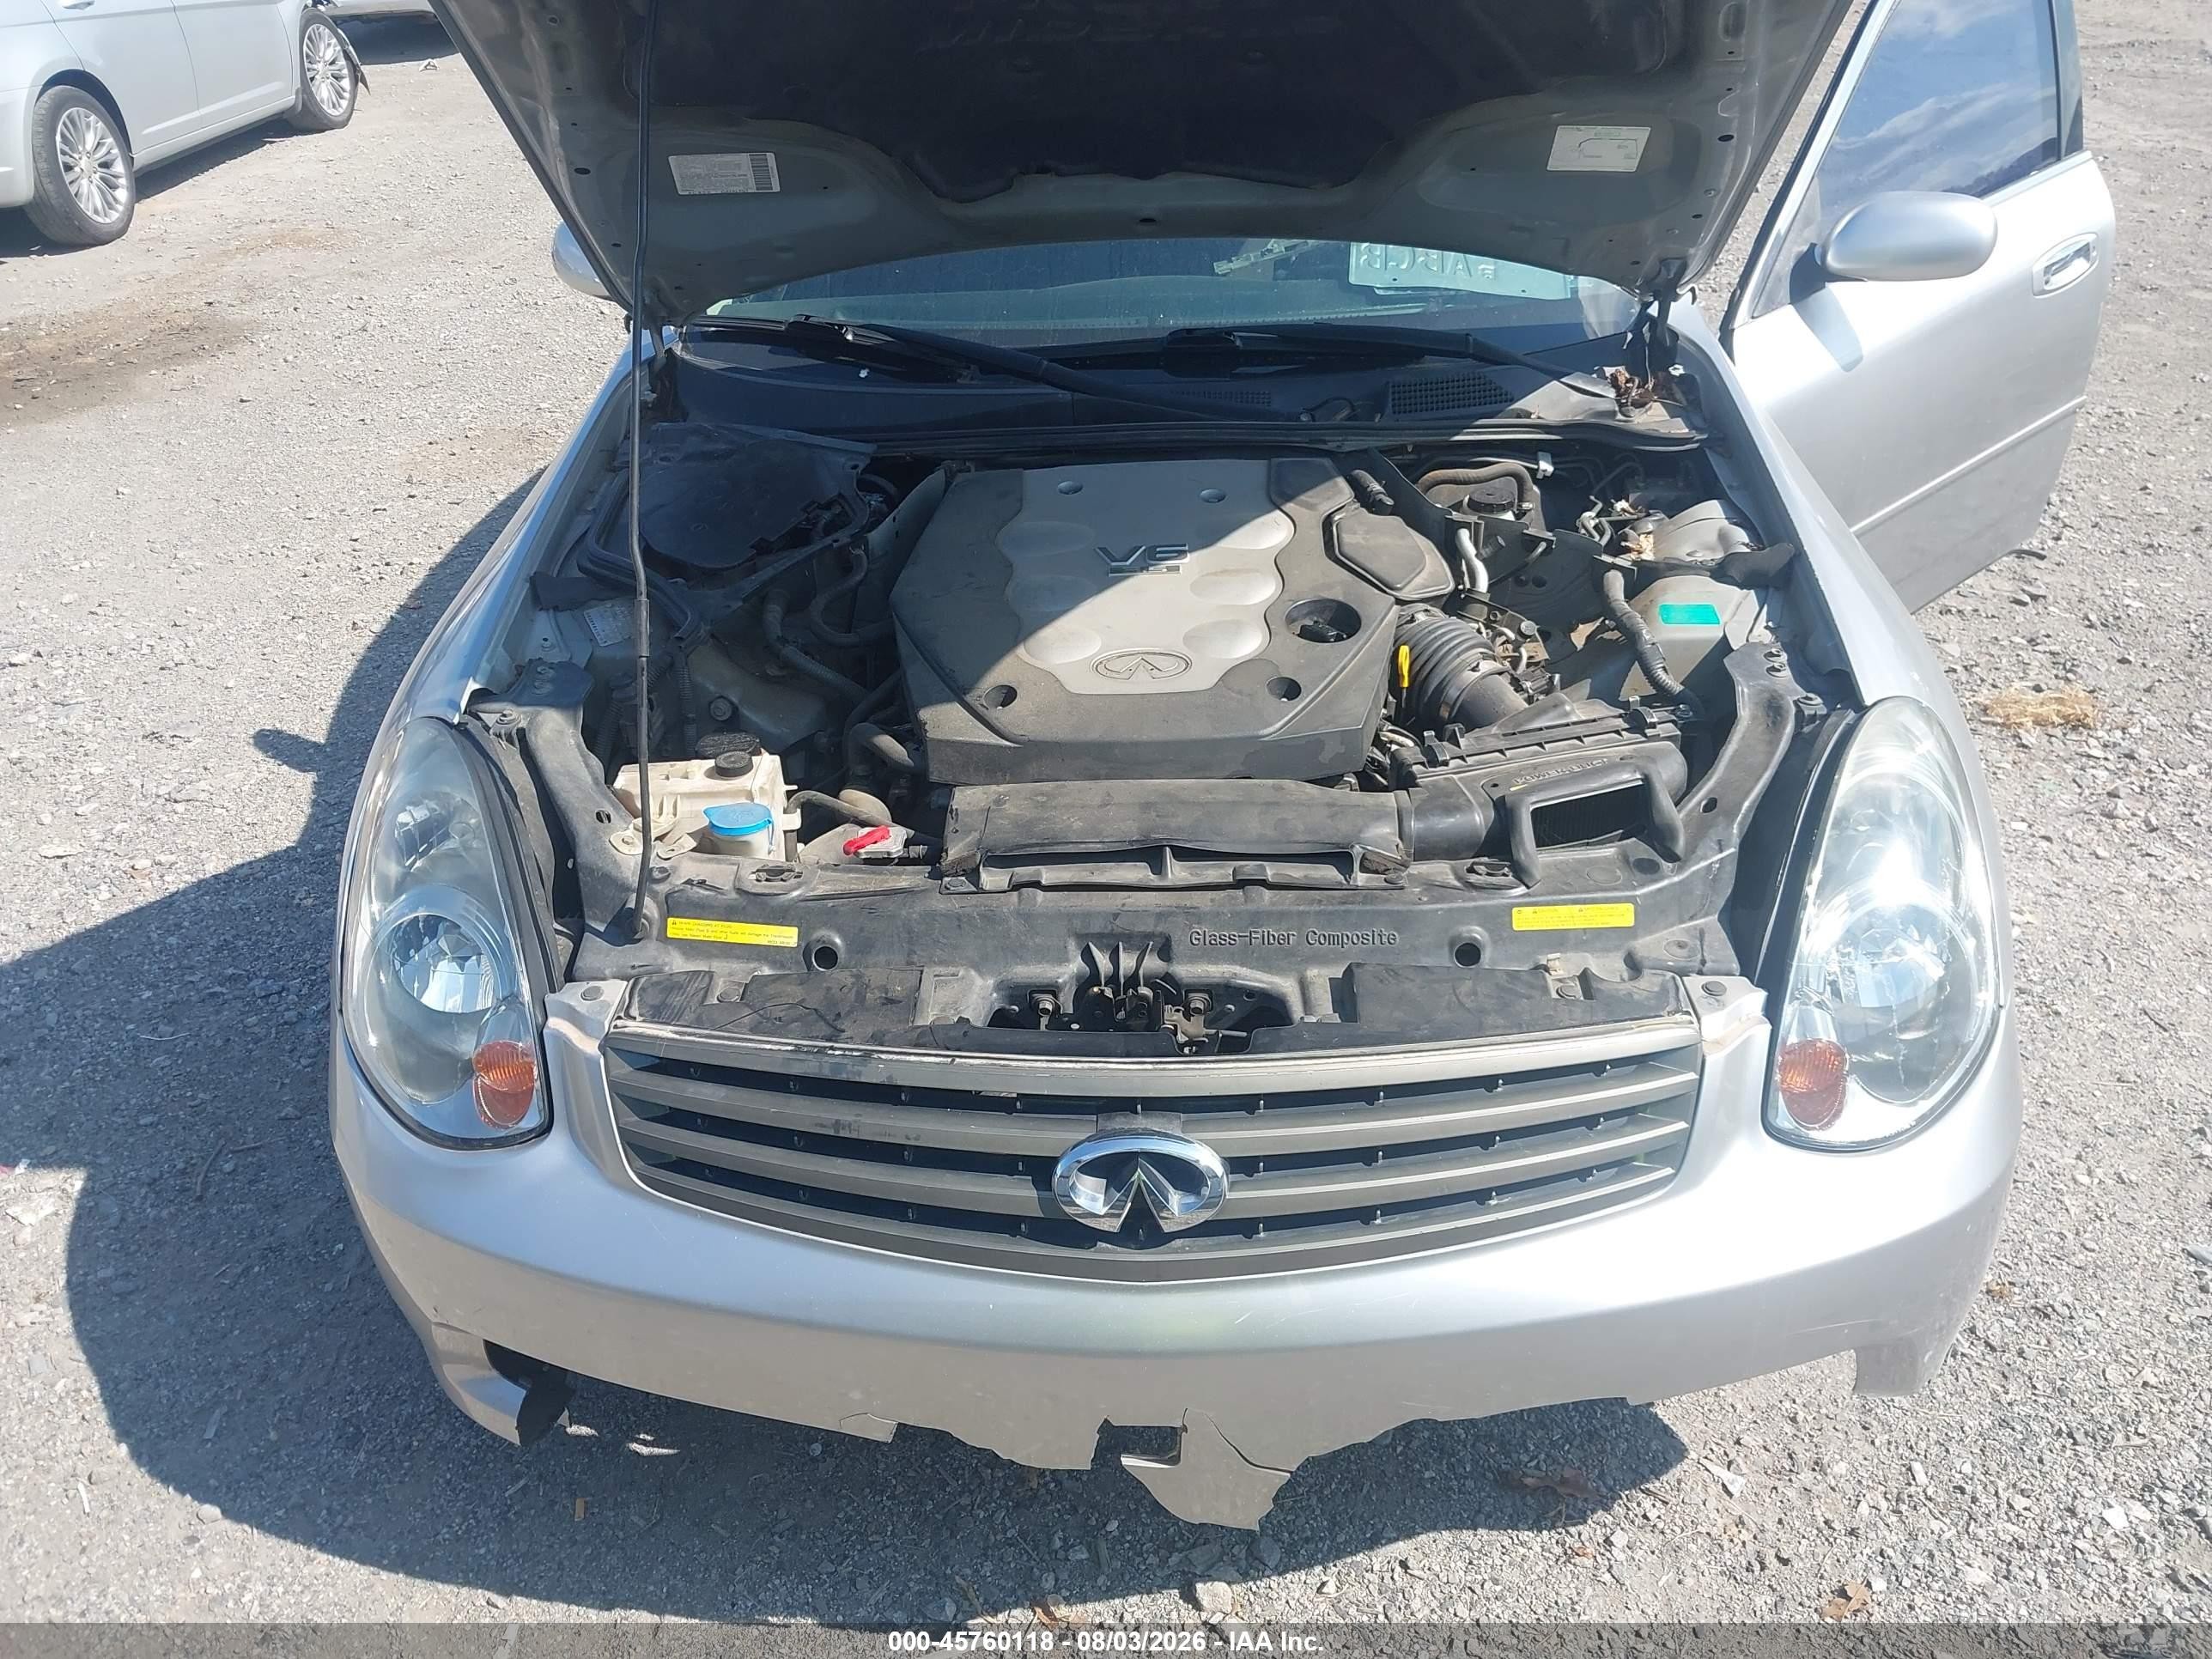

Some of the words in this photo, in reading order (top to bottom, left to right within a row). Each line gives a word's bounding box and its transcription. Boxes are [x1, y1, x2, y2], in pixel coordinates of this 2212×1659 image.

[1095, 544, 1190, 564] V6
[1189, 929, 1297, 947] Glass-Fiber
[1305, 928, 1400, 949] Composite
